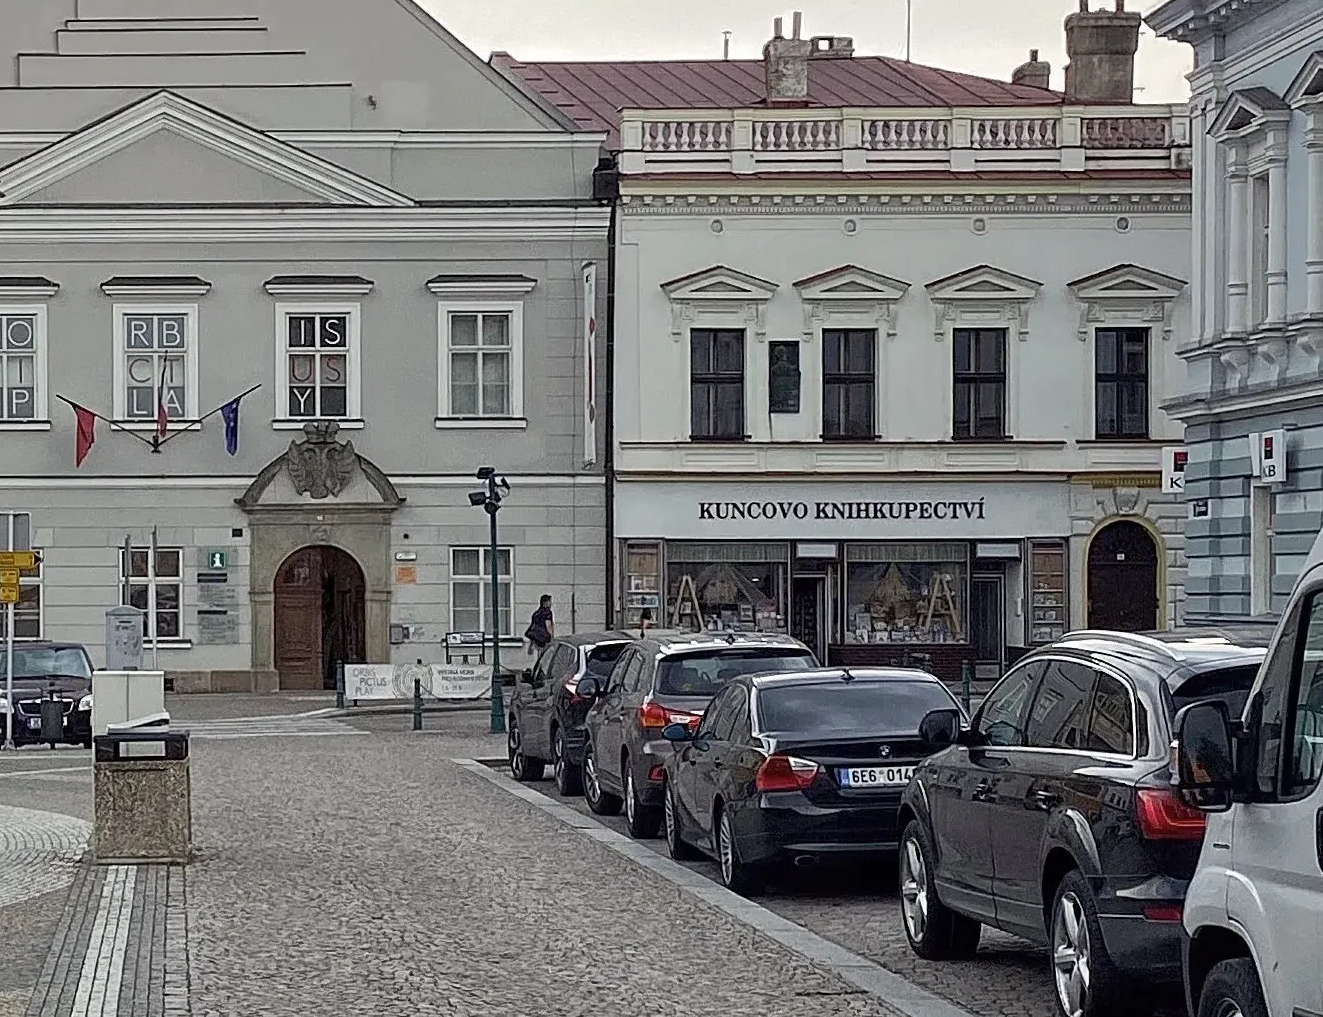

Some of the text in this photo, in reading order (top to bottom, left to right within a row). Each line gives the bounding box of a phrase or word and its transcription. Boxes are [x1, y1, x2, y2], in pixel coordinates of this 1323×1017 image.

[698, 496, 985, 520] KUNCOVO KNIHKUPECTVÍ
[852, 767, 917, 783] 6E6 014
